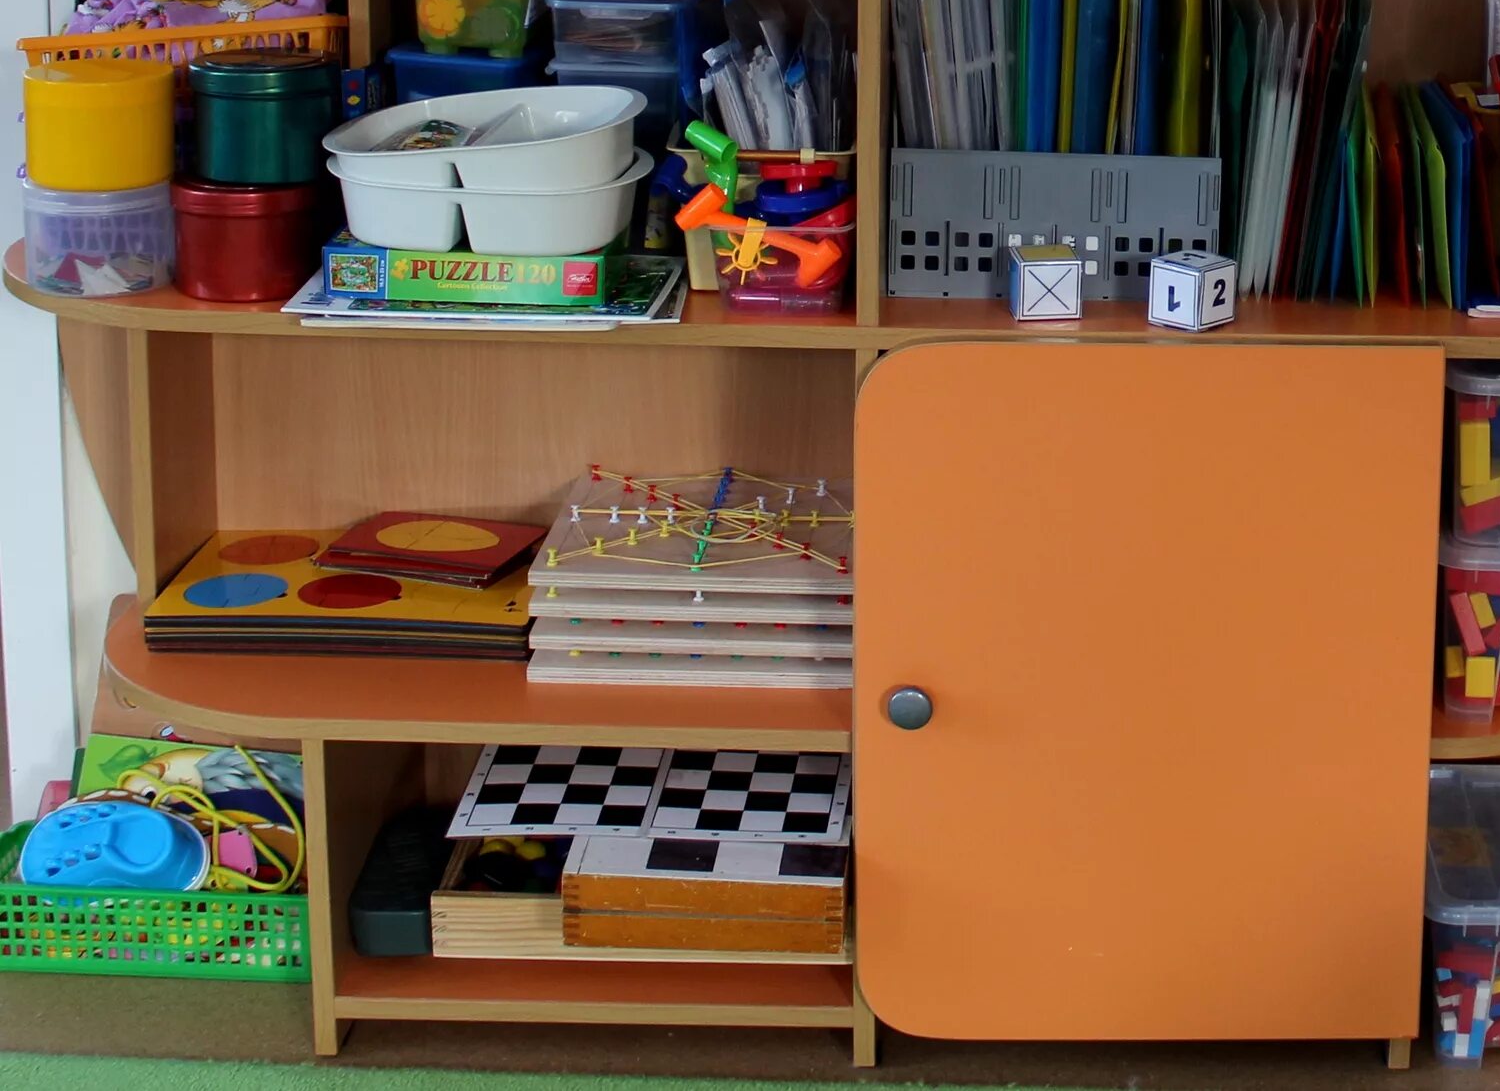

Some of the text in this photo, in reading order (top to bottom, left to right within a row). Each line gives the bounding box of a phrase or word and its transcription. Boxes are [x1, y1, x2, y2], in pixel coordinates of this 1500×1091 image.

[410, 259, 513, 282] PUZZLE
[517, 263, 556, 284] 120
[1212, 278, 1226, 307] 2
